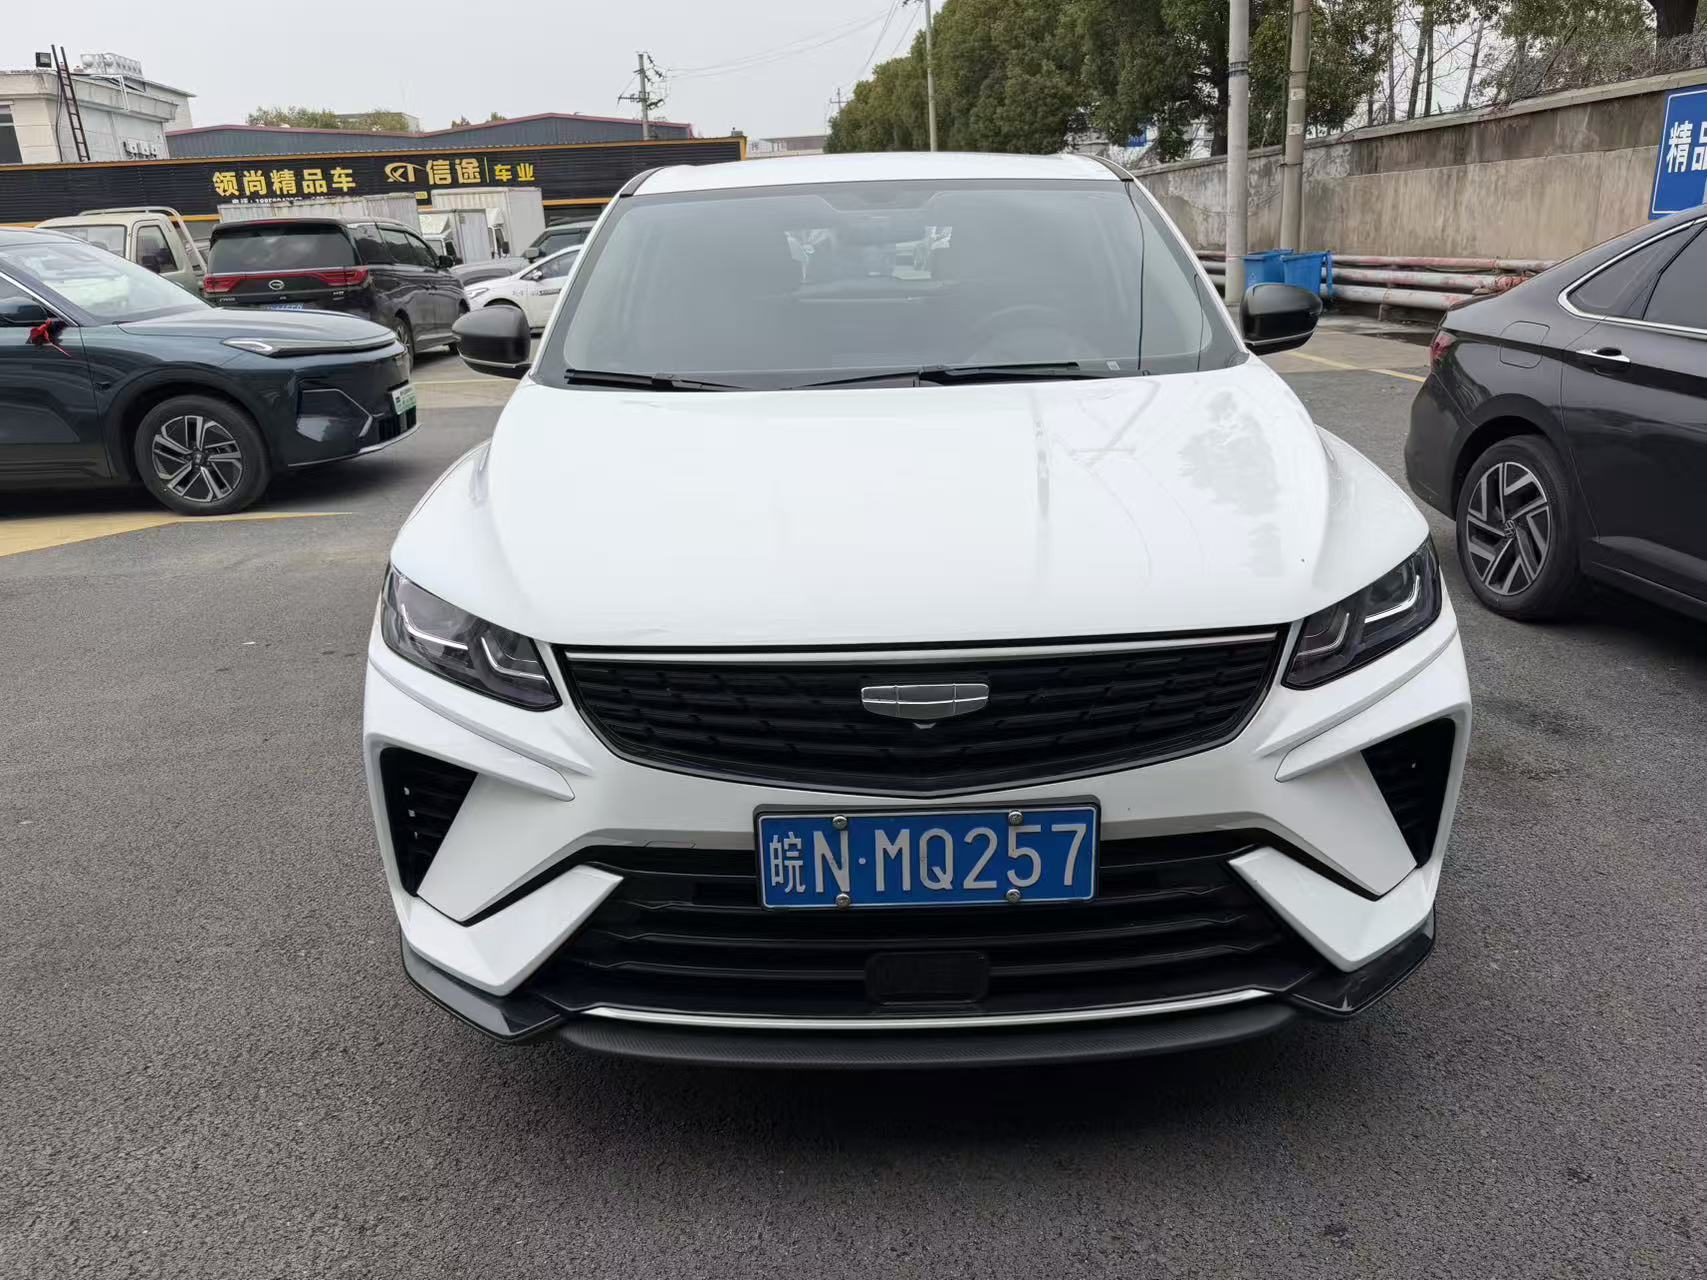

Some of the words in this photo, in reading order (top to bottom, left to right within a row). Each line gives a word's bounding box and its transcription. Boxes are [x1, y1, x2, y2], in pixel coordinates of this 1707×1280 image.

[212, 167, 356, 197] 领尚精品车
[426, 158, 481, 185] 信途
[493, 163, 535, 182] 车业
